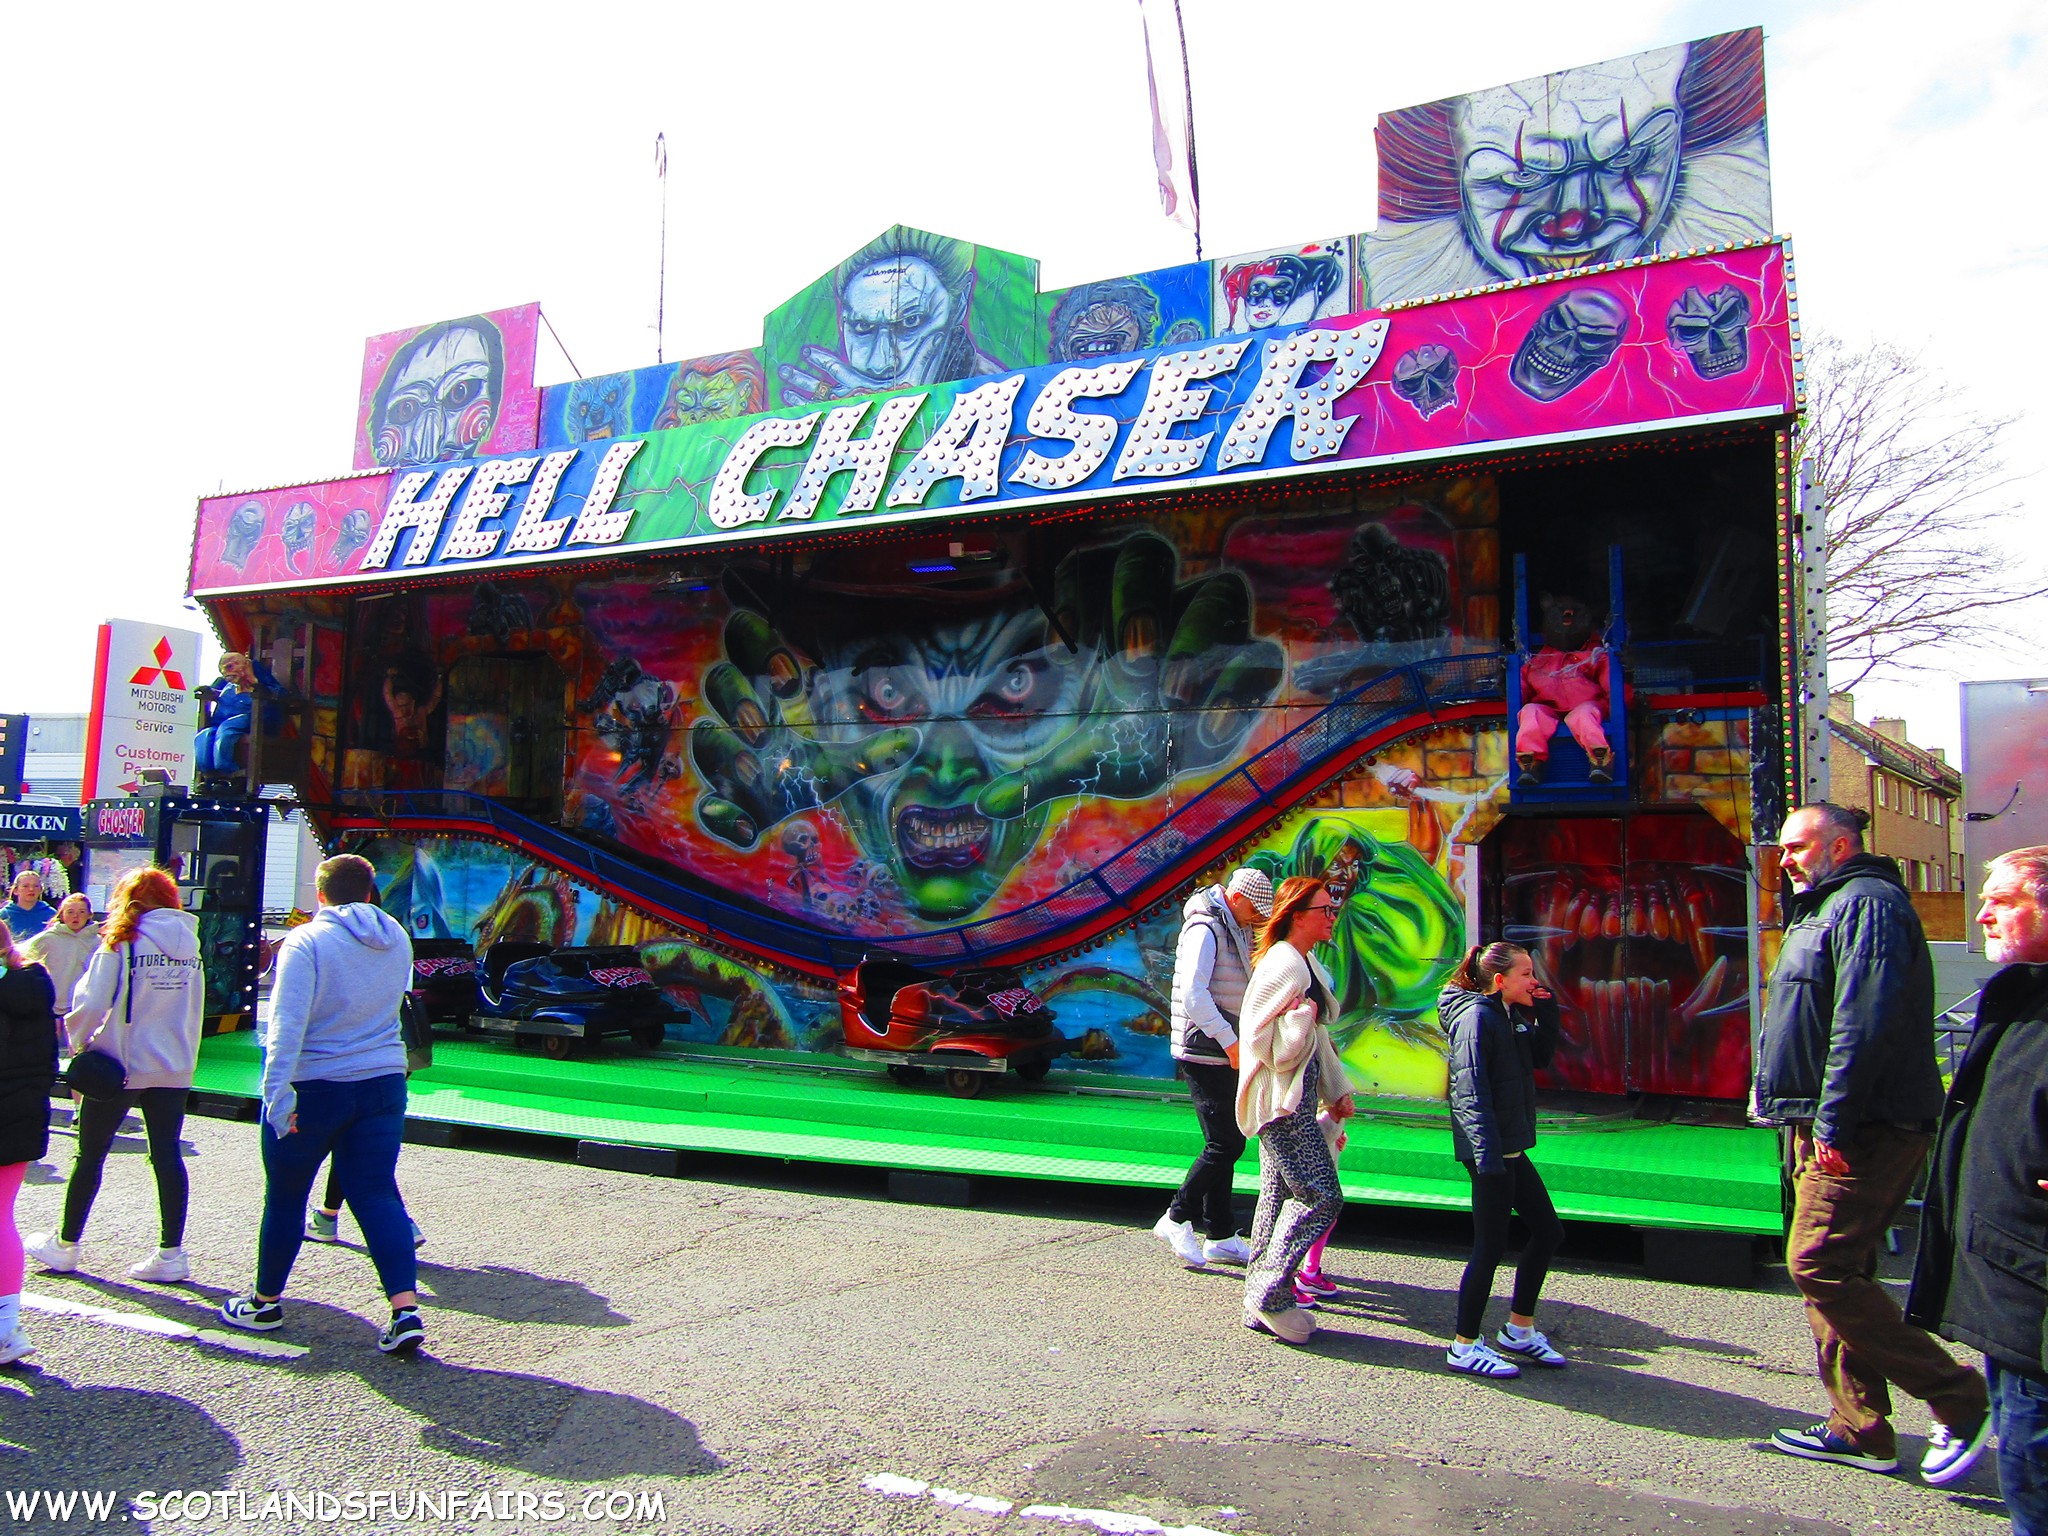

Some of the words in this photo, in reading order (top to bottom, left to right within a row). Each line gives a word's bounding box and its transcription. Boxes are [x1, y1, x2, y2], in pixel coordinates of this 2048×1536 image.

[359, 439, 646, 570] HELL
[709, 318, 1391, 529] CHASER
[131, 688, 184, 703] MITSUBISHI
[138, 701, 177, 714] MOTORS
[136, 719, 174, 734] Service
[115, 744, 185, 763] Customer
[98, 808, 146, 838] GHOSTER
[127, 954, 166, 969] UTURE
